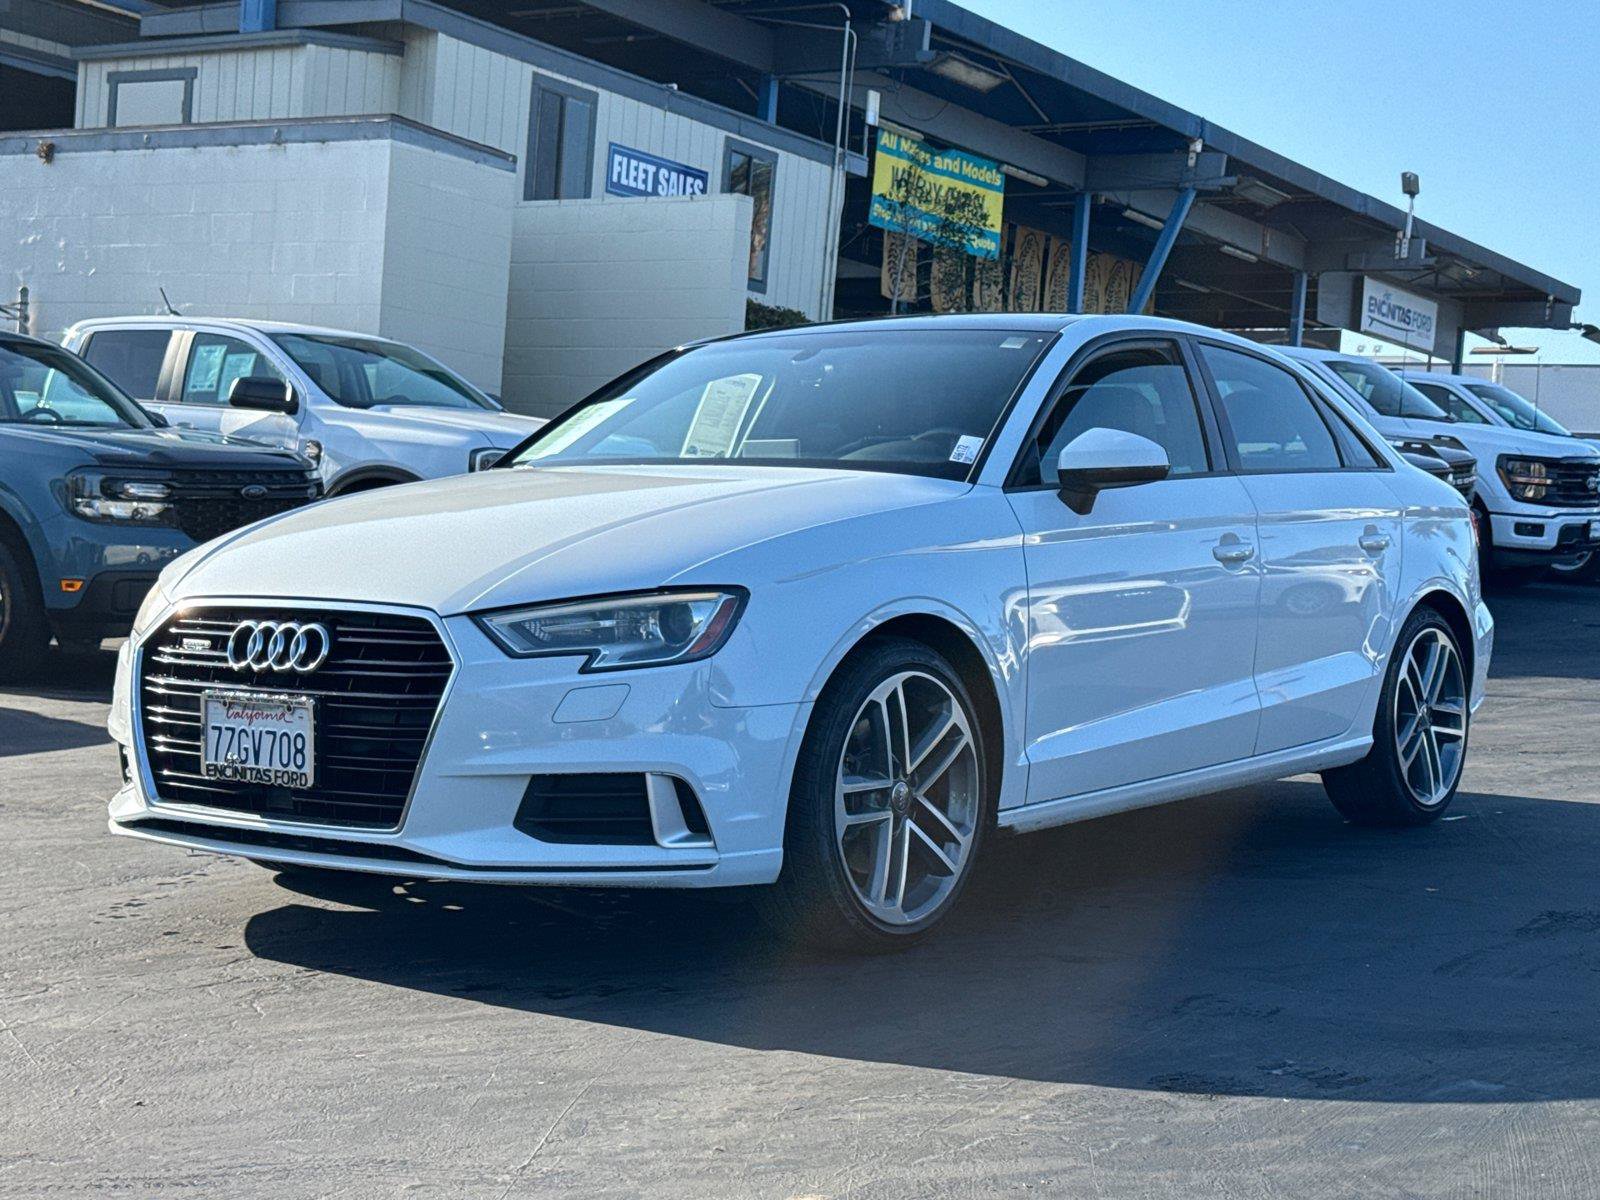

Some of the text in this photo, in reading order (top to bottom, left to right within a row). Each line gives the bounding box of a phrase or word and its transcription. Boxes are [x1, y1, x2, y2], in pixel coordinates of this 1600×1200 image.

[612, 153, 704, 197] FLEET SALES
[880, 130, 897, 149] All
[934, 155, 961, 174] and
[962, 161, 1002, 186] Models
[1367, 295, 1432, 333] ENCINITAS FORD
[226, 702, 294, 726] California
[211, 725, 306, 770] 7ZGV708
[205, 763, 309, 788] ENCINITAS FORD
